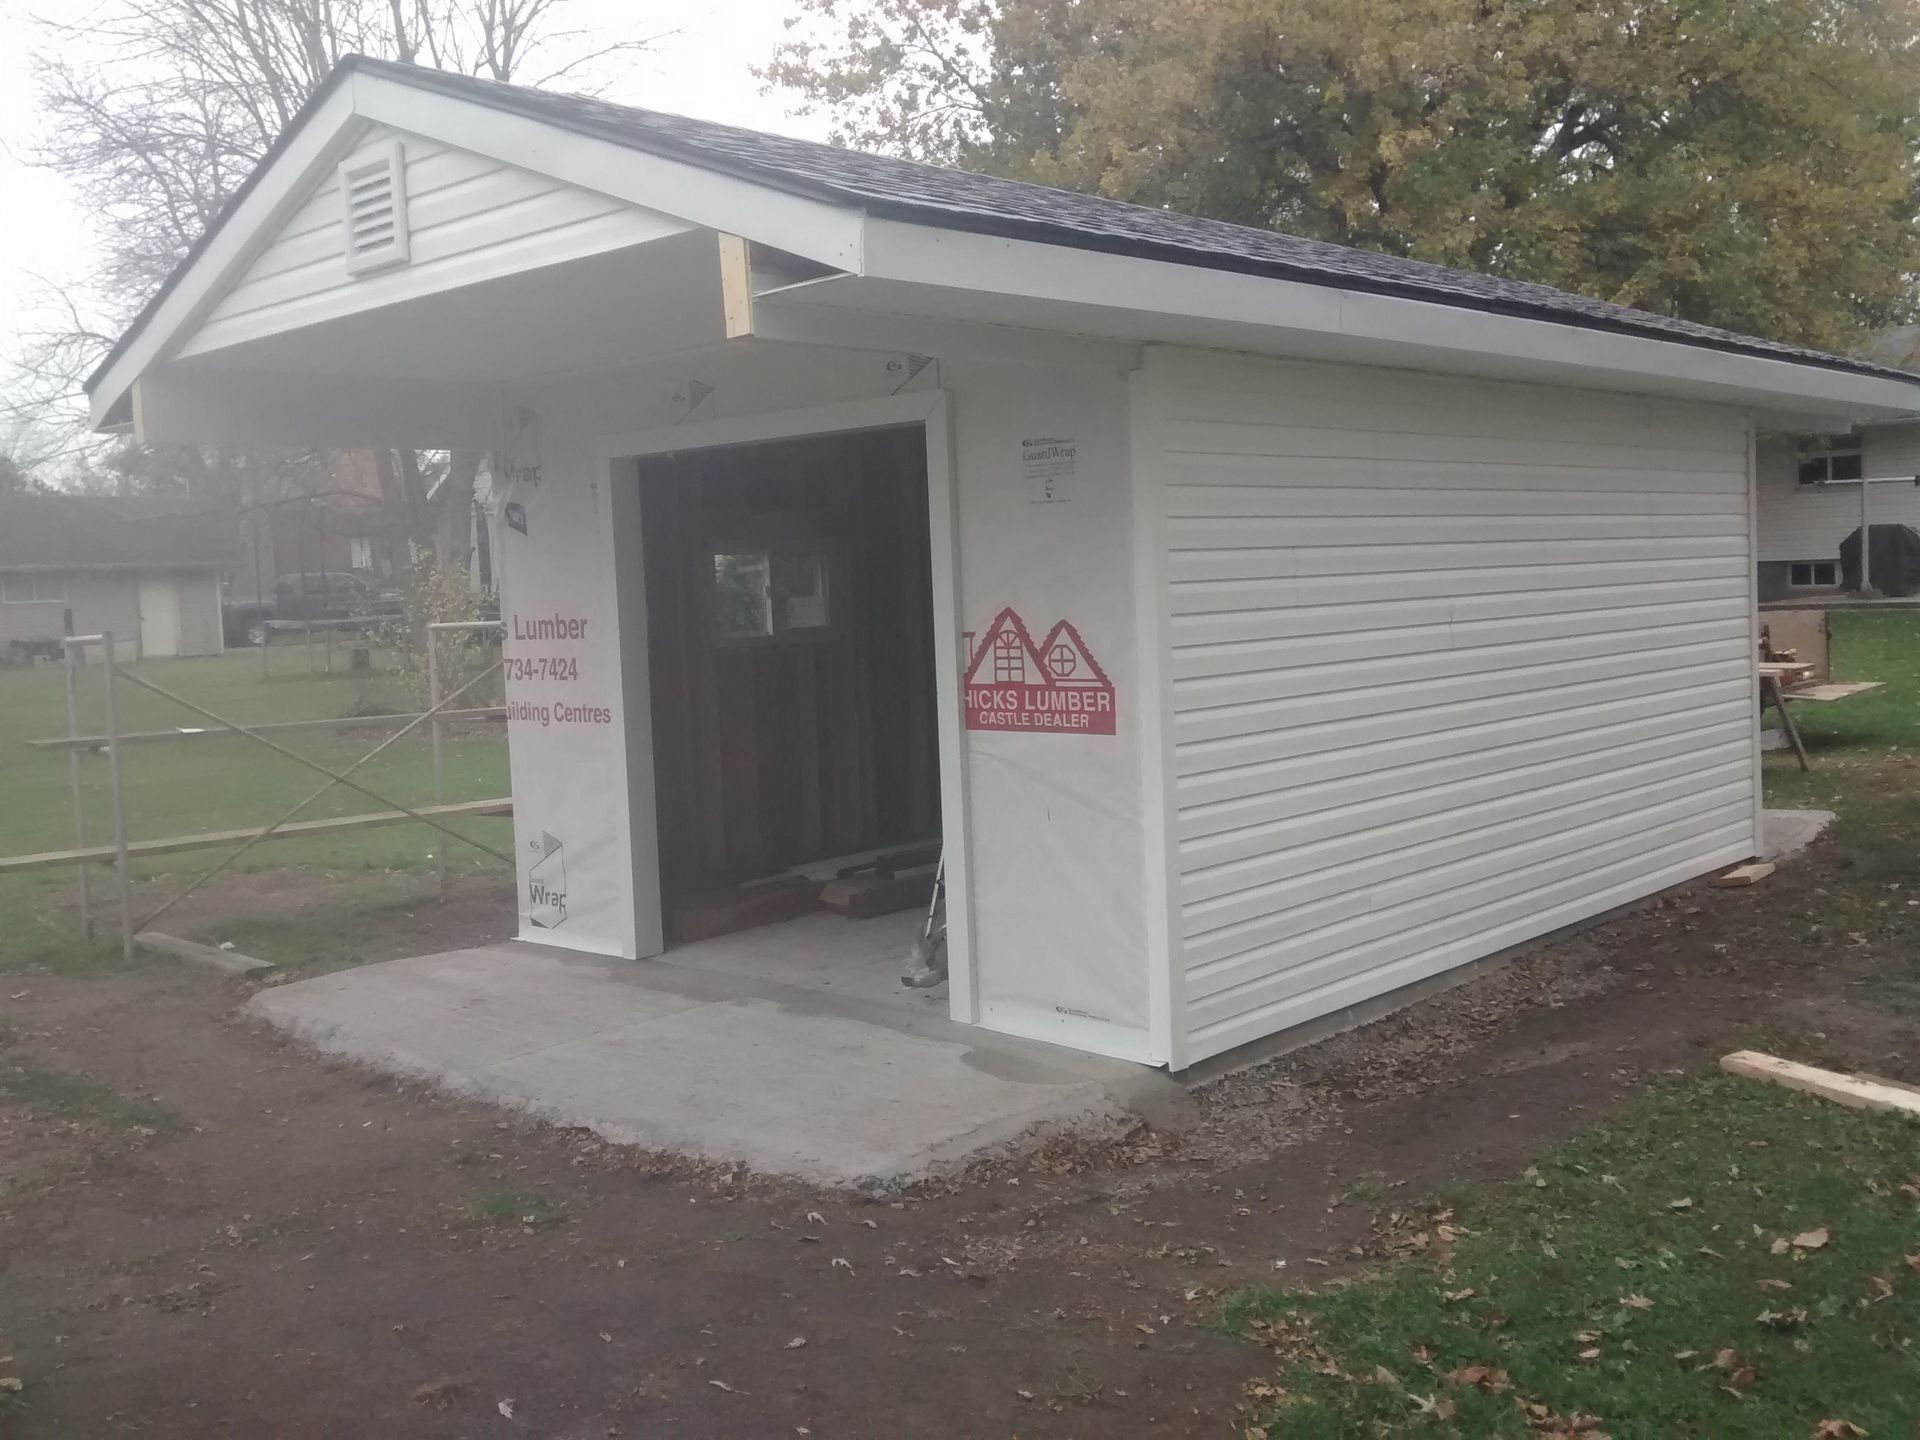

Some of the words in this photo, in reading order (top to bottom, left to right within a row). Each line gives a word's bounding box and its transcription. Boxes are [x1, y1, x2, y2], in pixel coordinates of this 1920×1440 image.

[513, 612, 588, 641] Lumber
[503, 657, 579, 681] 734-7424
[553, 702, 612, 724] Centres
[964, 689, 1018, 710] HICKS
[1024, 691, 1111, 713] LUMBER
[979, 711, 1031, 726] CASTLE
[1034, 713, 1090, 729] DEALER
[530, 884, 567, 914] Wrap
